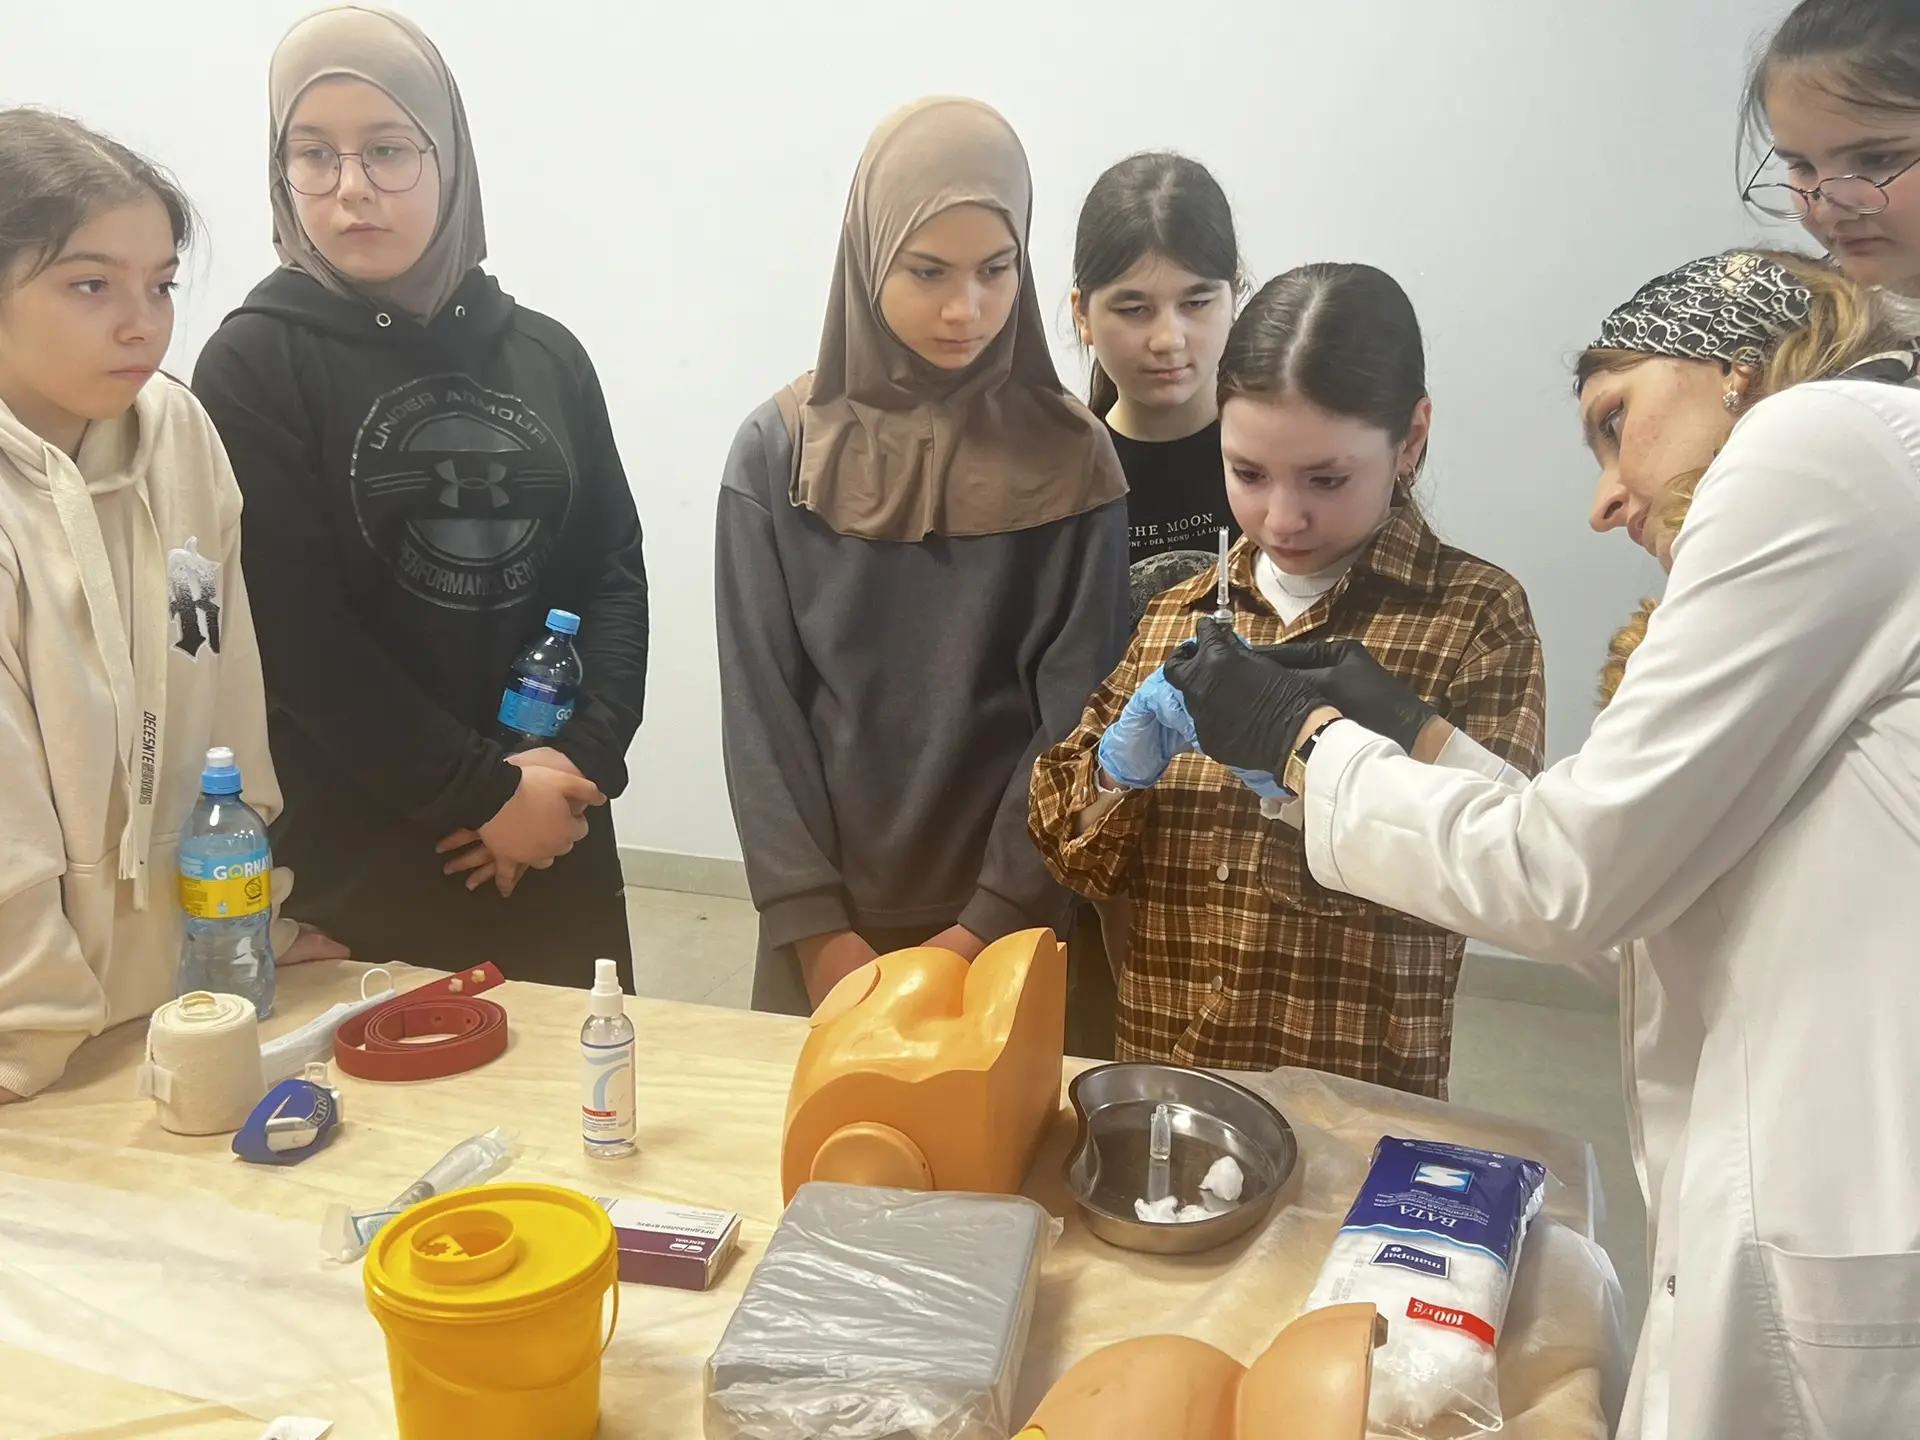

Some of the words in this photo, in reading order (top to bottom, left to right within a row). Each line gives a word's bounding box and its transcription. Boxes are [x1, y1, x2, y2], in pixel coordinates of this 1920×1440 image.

[369, 391, 437, 451] UNDER
[445, 388, 548, 446] ARMOUR
[1128, 524, 1159, 538] THE
[1166, 513, 1213, 534] MOON
[1149, 538, 1165, 546] DER
[1167, 533, 1190, 544] MOND
[1196, 529, 1206, 537] LA
[1400, 1204, 1458, 1228] ВАТА
[675, 1237, 706, 1246] RENEWAL
[1383, 1250, 1442, 1270] matopat
